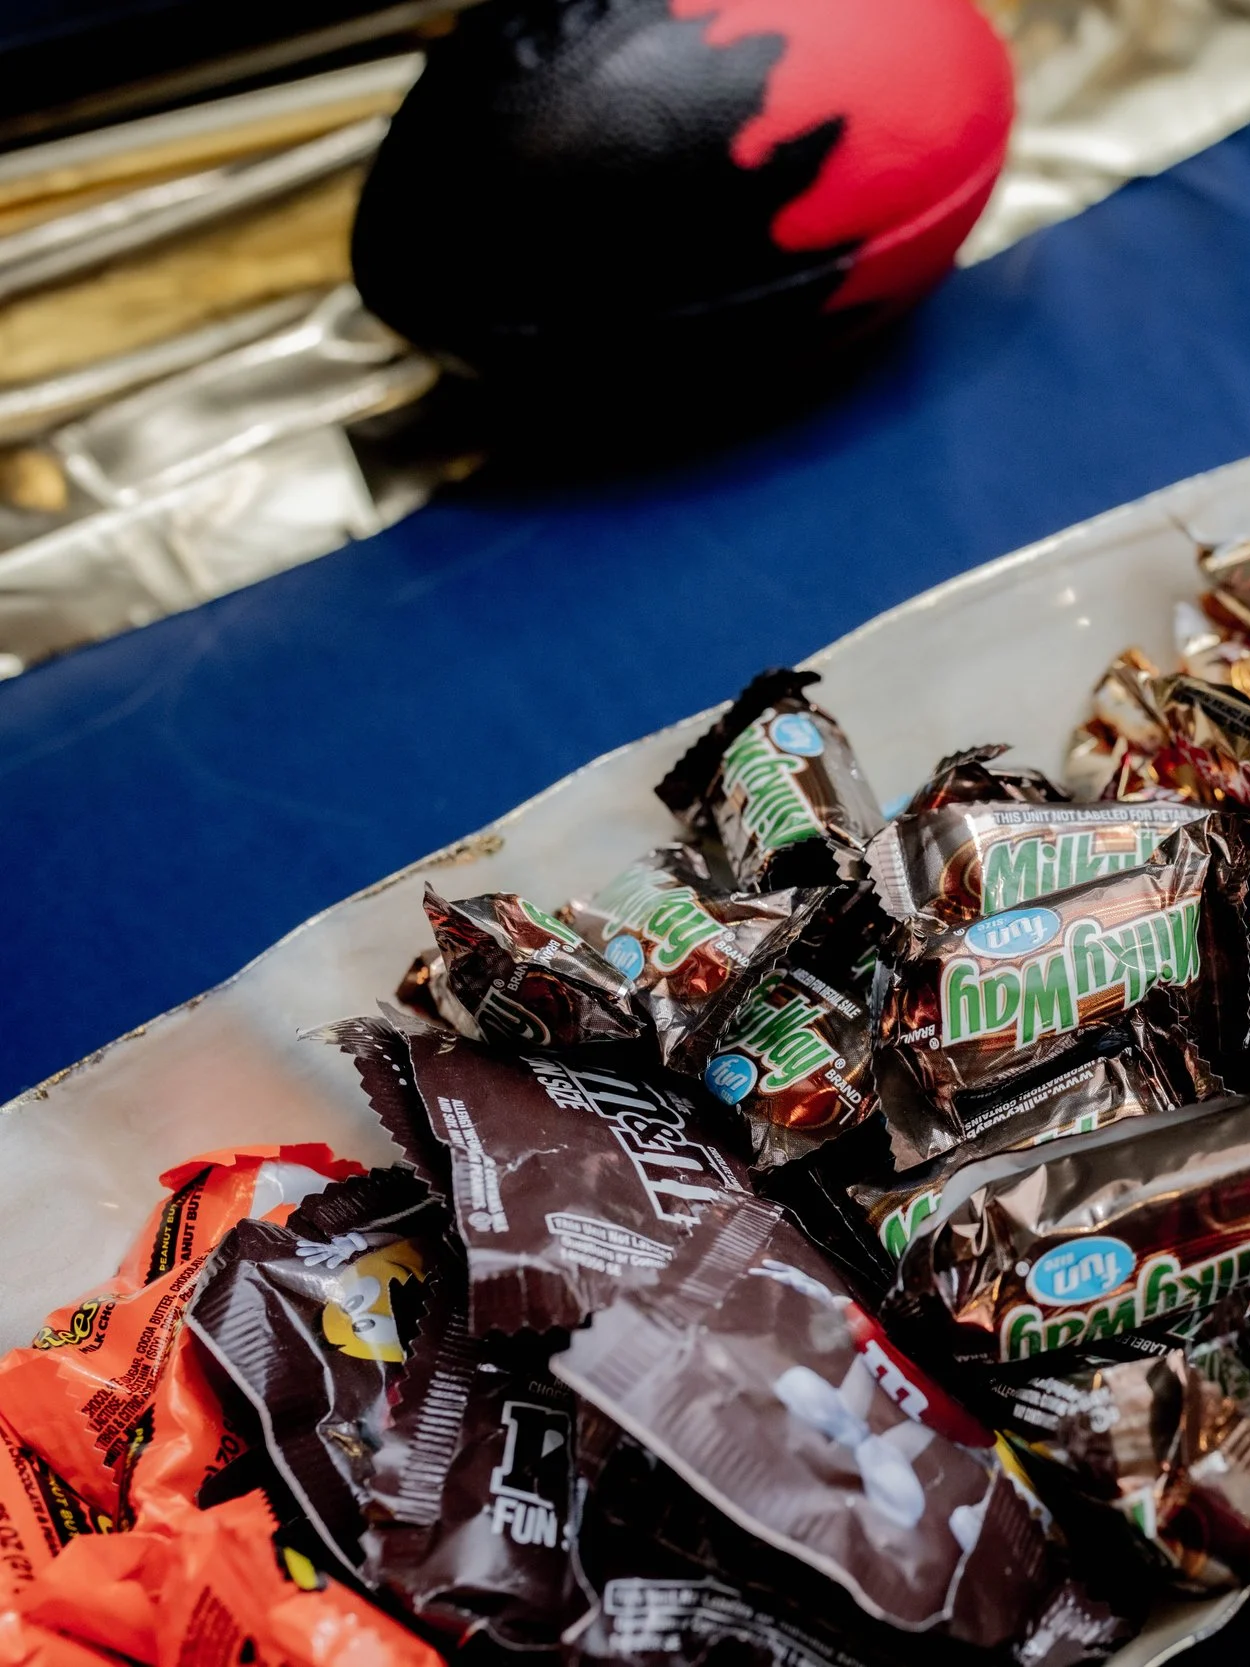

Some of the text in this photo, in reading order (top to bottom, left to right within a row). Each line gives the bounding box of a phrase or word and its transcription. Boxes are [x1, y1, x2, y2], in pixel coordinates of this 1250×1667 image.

[994, 812, 1022, 824] THIS
[1024, 811, 1051, 823] UNIT
[1054, 809, 1076, 822] NOT
[1078, 810, 1129, 821] LABELED
[1130, 810, 1152, 821] FOR
[984, 915, 1045, 949] fun
[942, 898, 1200, 1049] Way Milky
[837, 999, 863, 1020] SALE
[713, 1057, 750, 1092] fun
[824, 1069, 863, 1105] BRAND
[538, 1075, 593, 1111] SIZE
[451, 1100, 472, 1127] ALLERGY
[159, 1226, 173, 1271] PEANUT
[1052, 1252, 1121, 1296] fun
[135, 1323, 157, 1354] COCOA
[149, 1290, 177, 1326] BUTTER,
[79, 1333, 105, 1354] MILK
[90, 1394, 127, 1434] LACTOSE,
[114, 1417, 127, 1429] &
[119, 1395, 146, 1422] CITRIC
[97, 1422, 122, 1448] TBHQ
[492, 1495, 558, 1549] FUN
